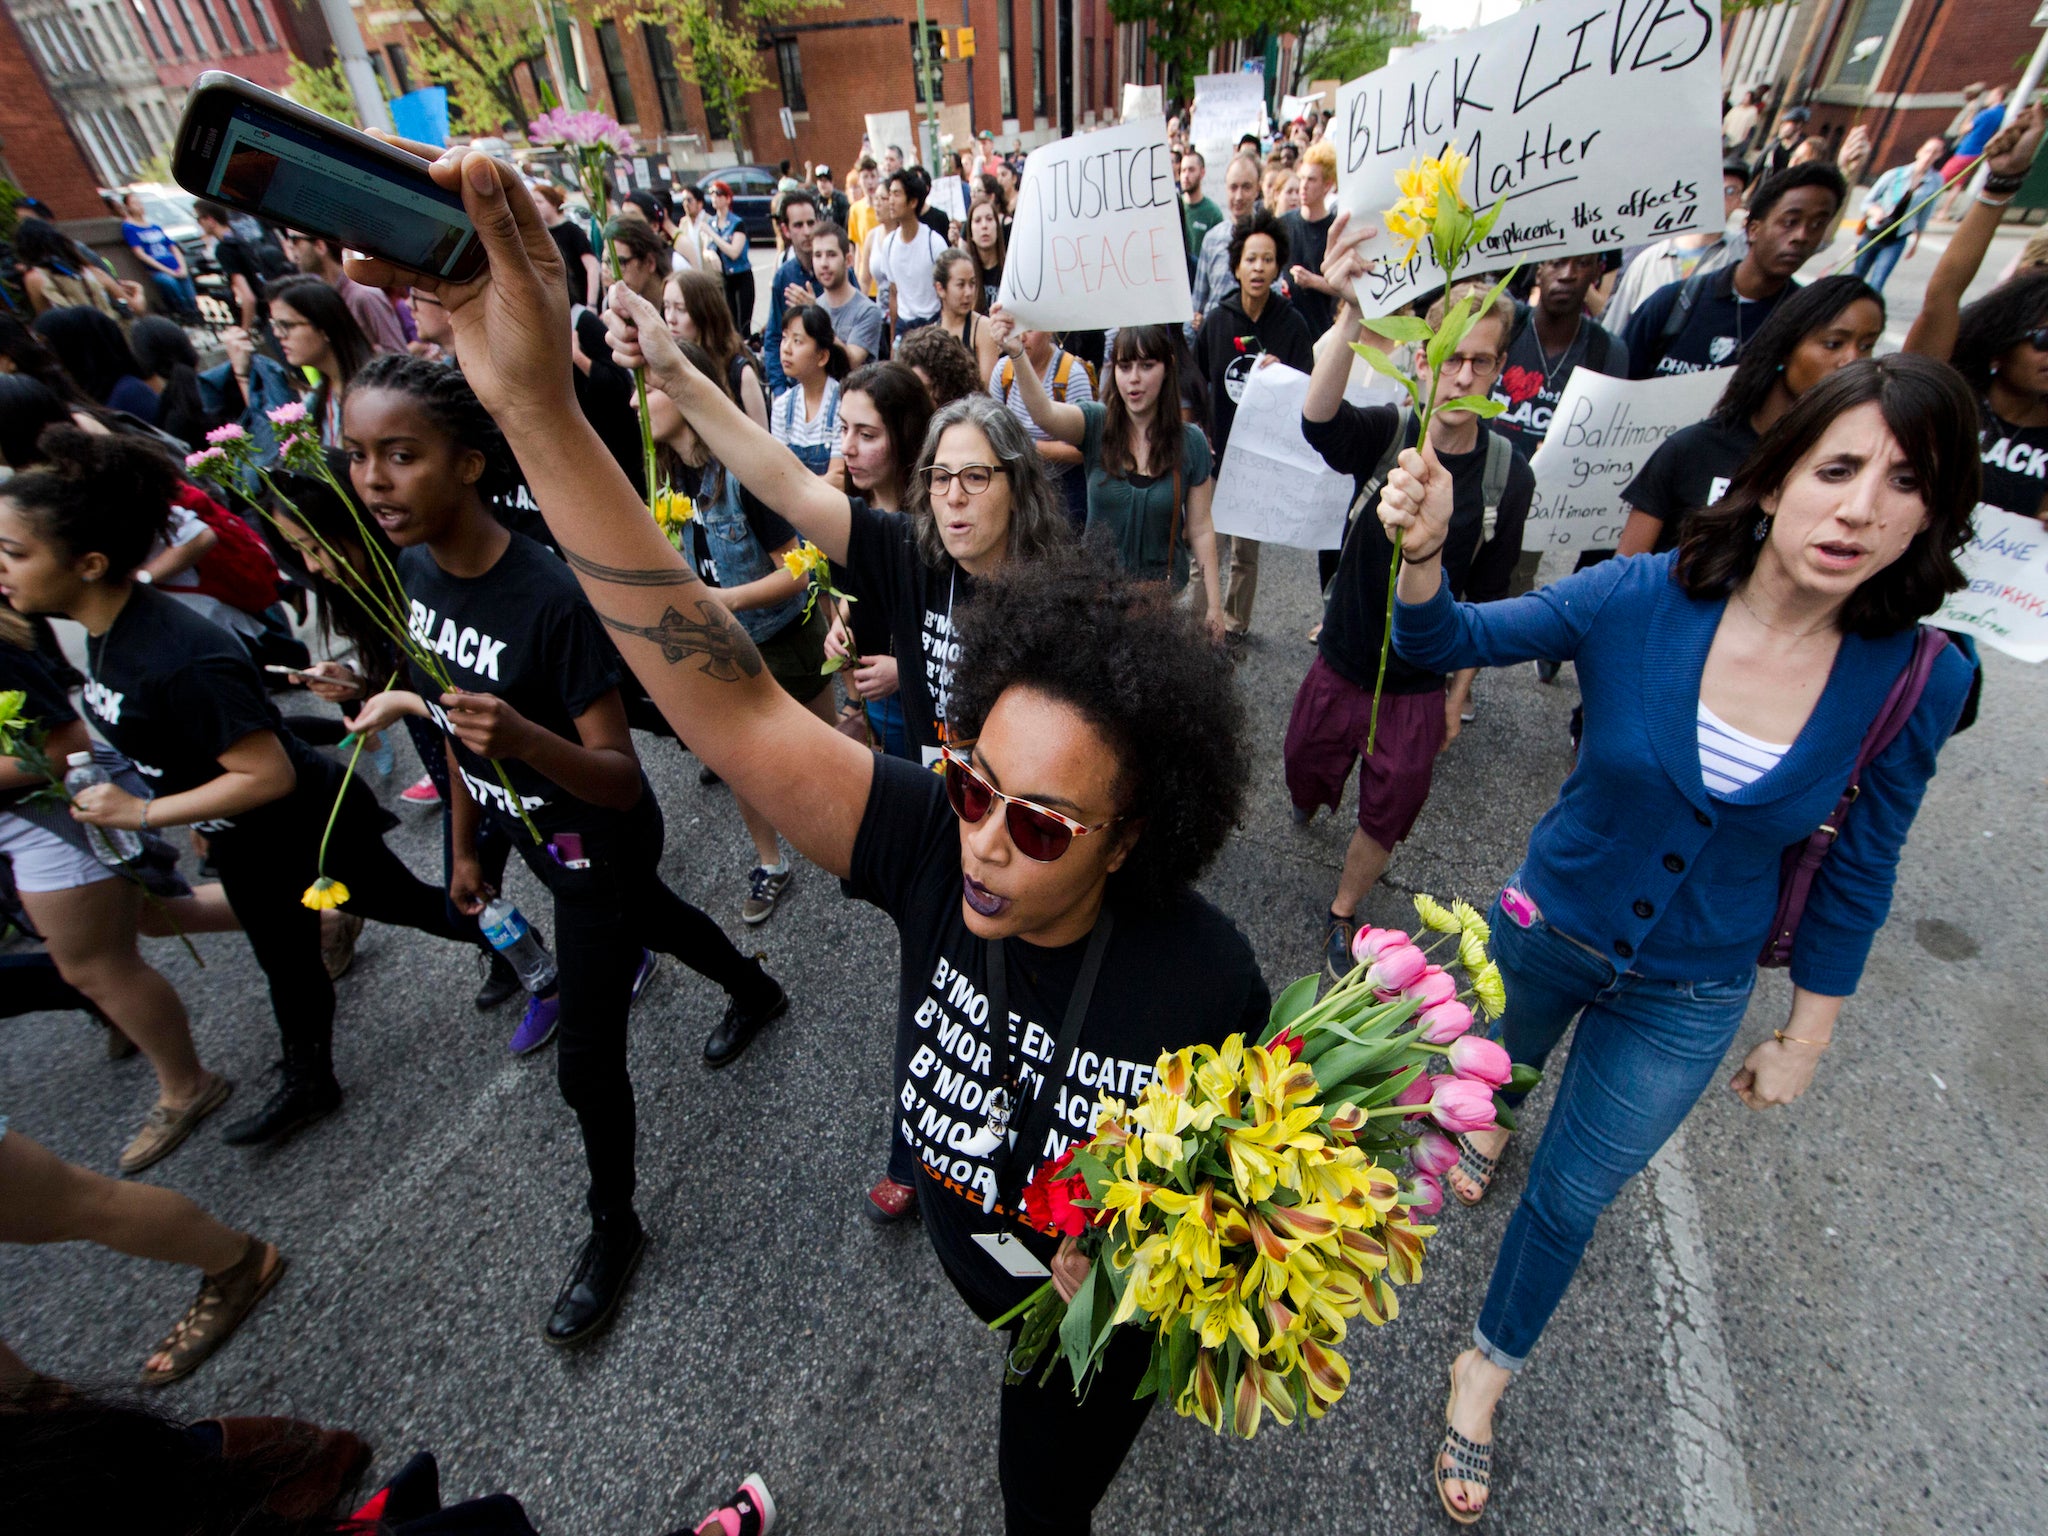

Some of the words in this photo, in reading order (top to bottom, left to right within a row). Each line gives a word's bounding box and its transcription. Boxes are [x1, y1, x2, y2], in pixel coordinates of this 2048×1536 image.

[1346, 53, 1494, 174] BLACK
[1512, 0, 1713, 114] LIVES
[1047, 142, 1172, 223] JUSTICE
[1572, 202, 1603, 228] this
[1617, 179, 1699, 217] affects
[1051, 226, 1173, 295] PEACE
[1592, 225, 1625, 244] us
[1562, 395, 1678, 448] Baltimore
[1549, 524, 1572, 544] to
[407, 599, 507, 682] BLACK
